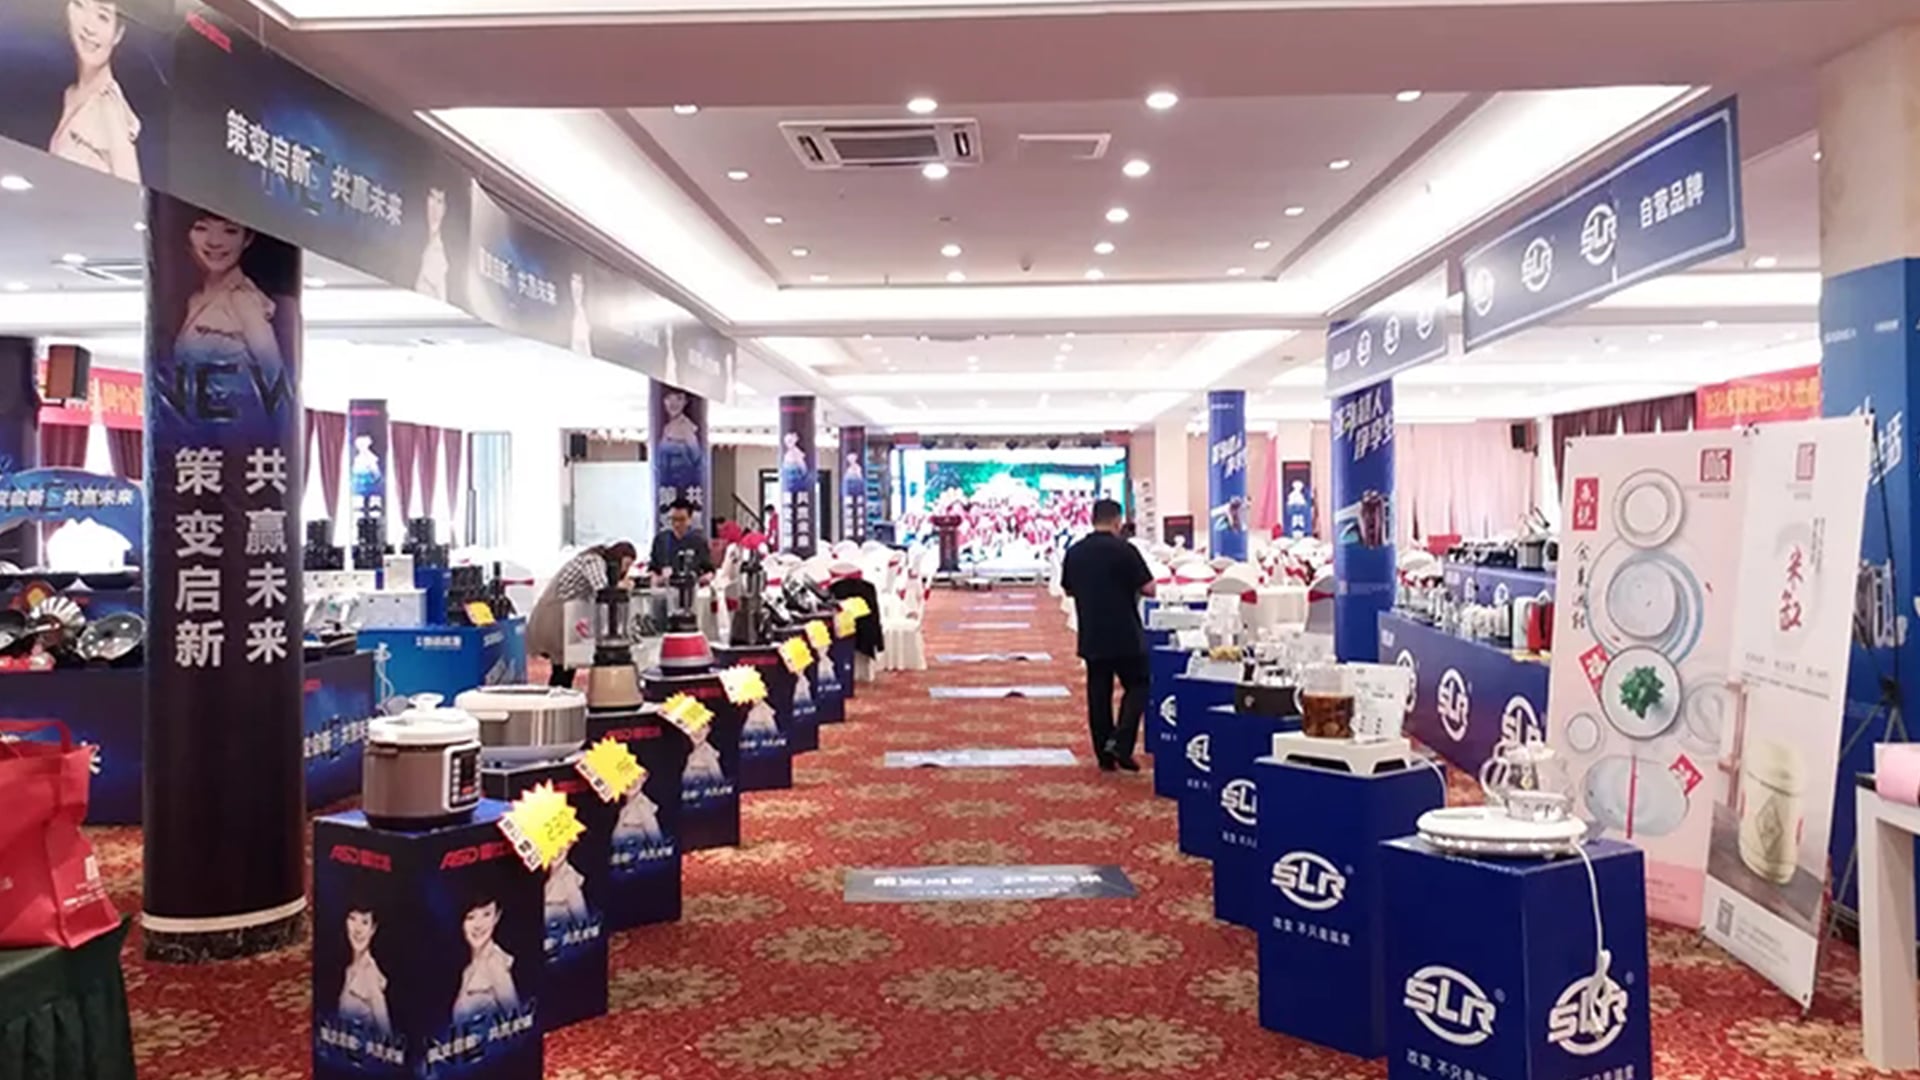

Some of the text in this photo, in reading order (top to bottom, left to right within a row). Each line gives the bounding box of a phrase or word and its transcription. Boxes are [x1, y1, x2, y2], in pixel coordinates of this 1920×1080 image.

[226, 109, 402, 225] 策变启新 共赢未来
[1641, 171, 1704, 228] 自营品牌
[1581, 210, 1617, 260] SLR
[175, 448, 224, 667] 策变启新
[245, 448, 288, 664] 共赢未来
[1271, 858, 1346, 900] SLR
[1403, 975, 1497, 1037] SLR
